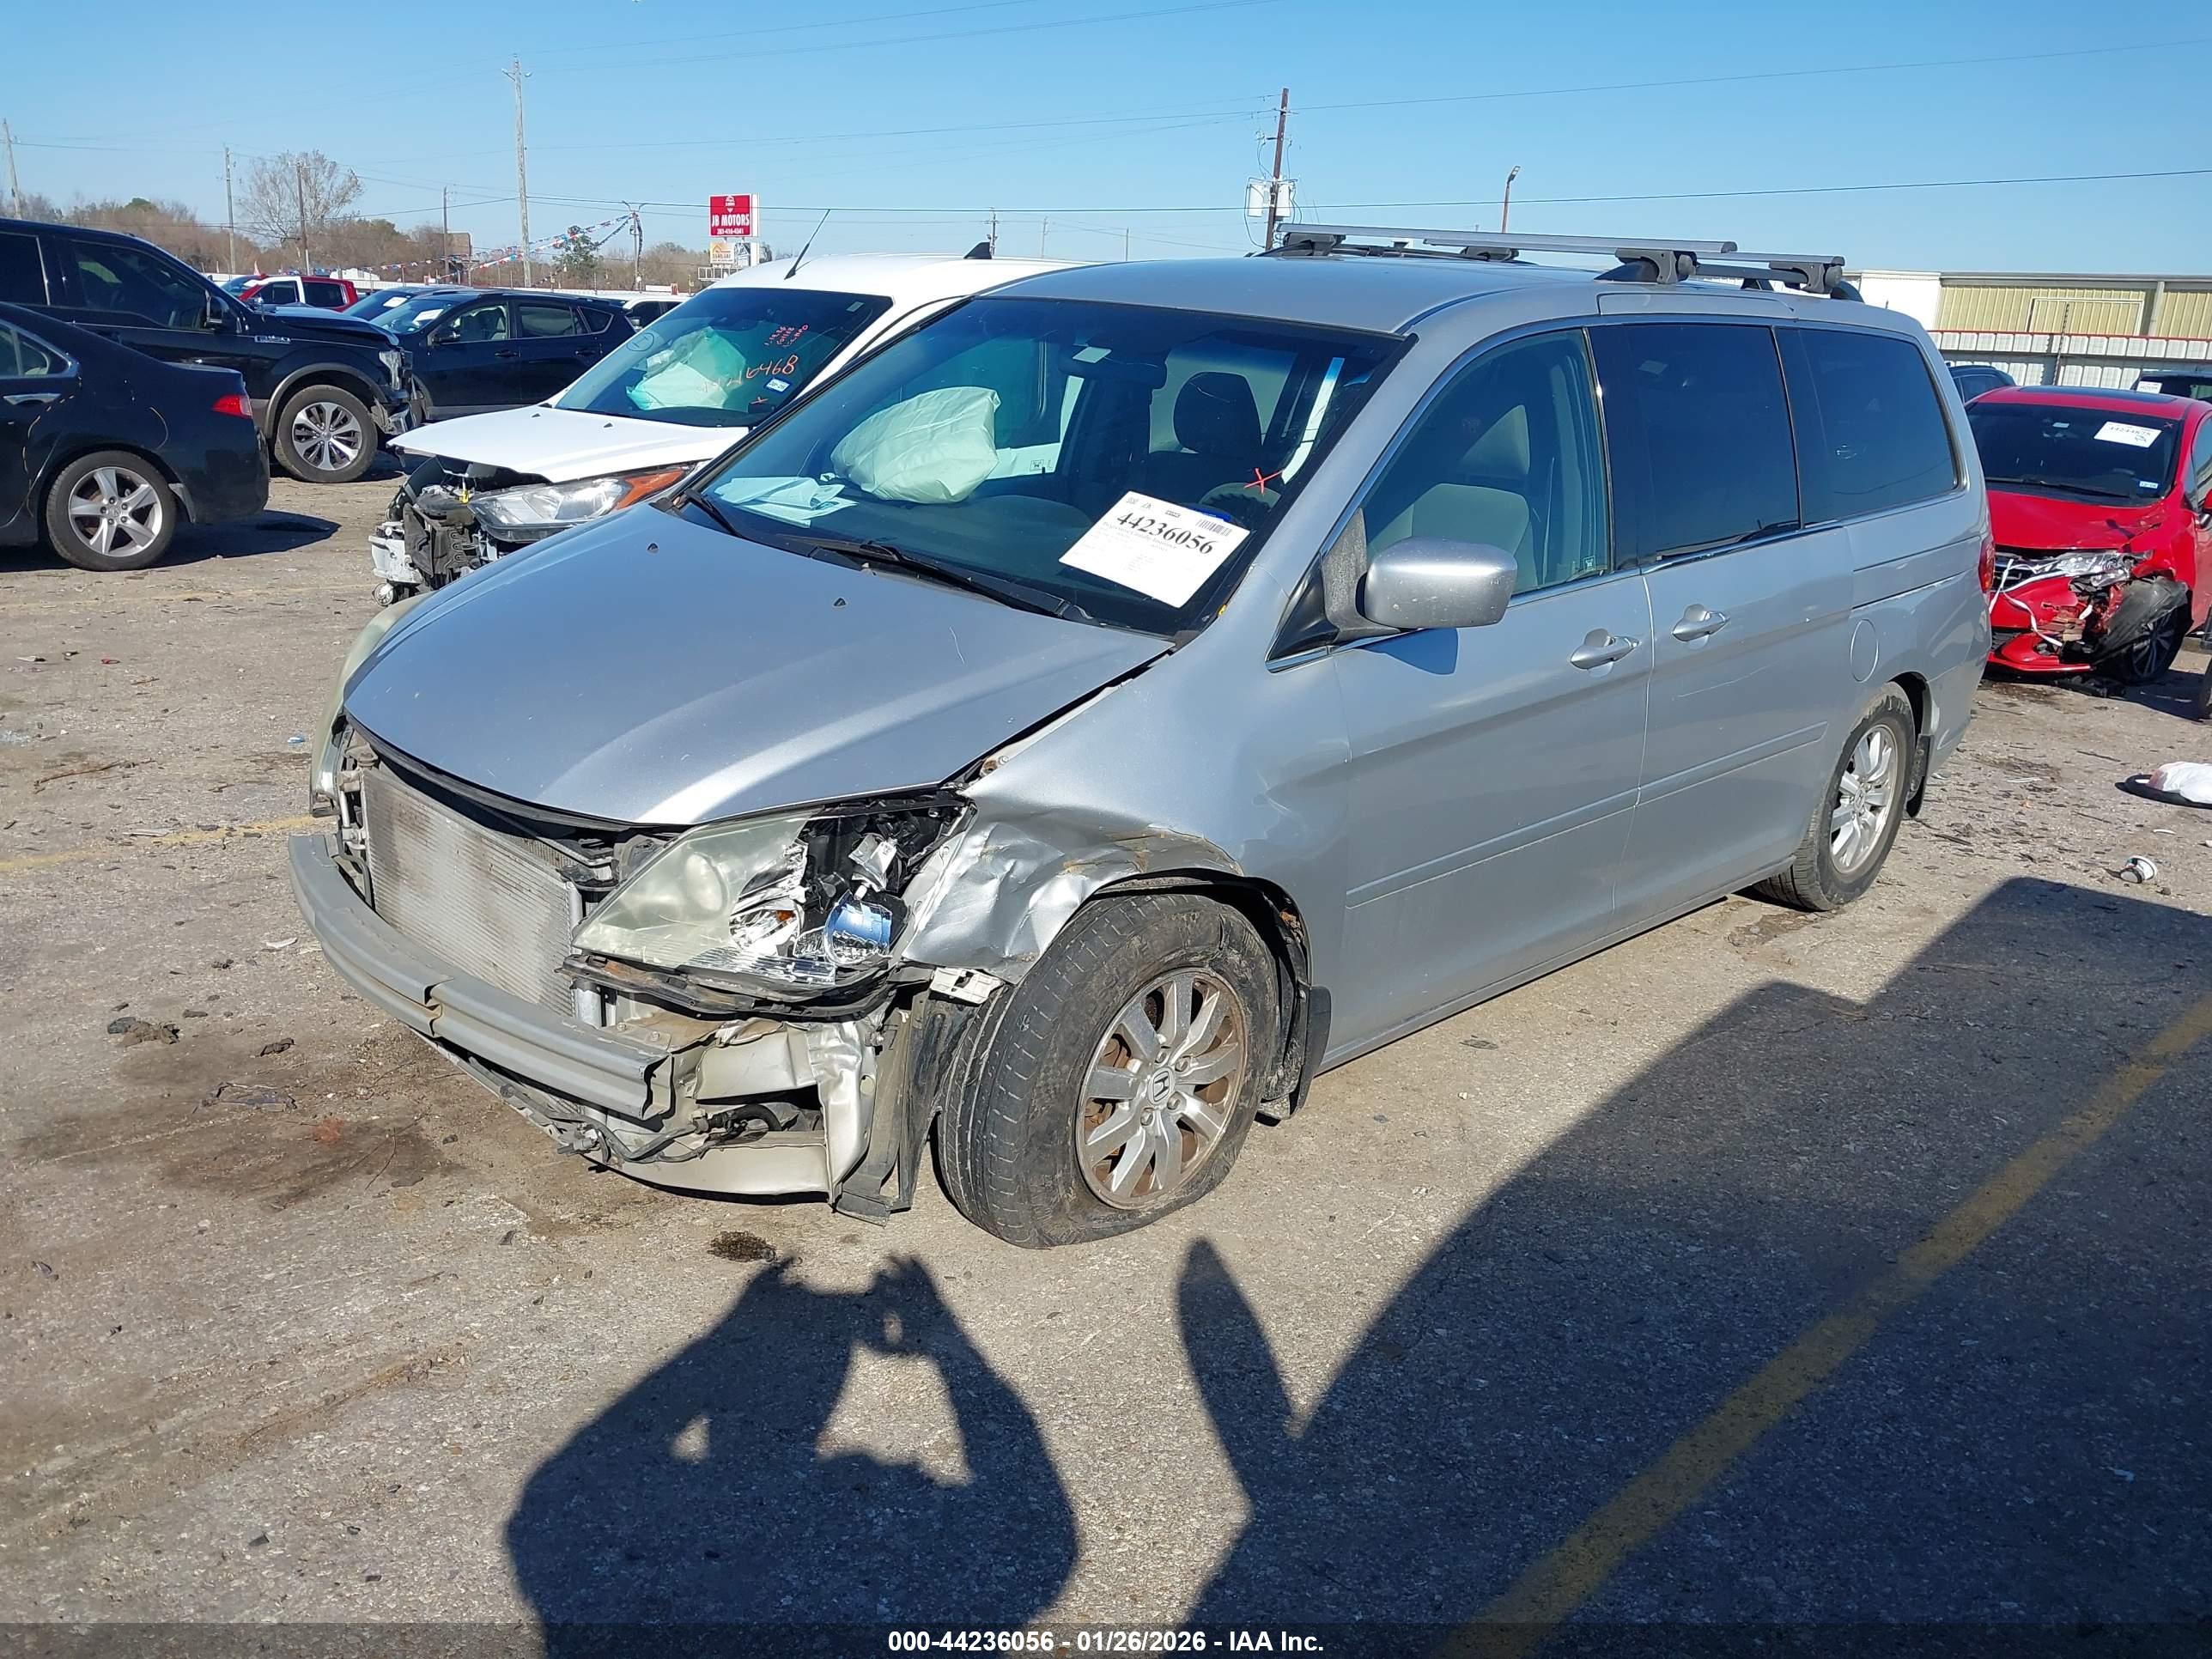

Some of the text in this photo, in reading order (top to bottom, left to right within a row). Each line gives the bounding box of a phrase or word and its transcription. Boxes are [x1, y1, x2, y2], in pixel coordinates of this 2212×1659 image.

[712, 214, 750, 227] JB MOTORS
[1117, 512, 1218, 555] 44236056
